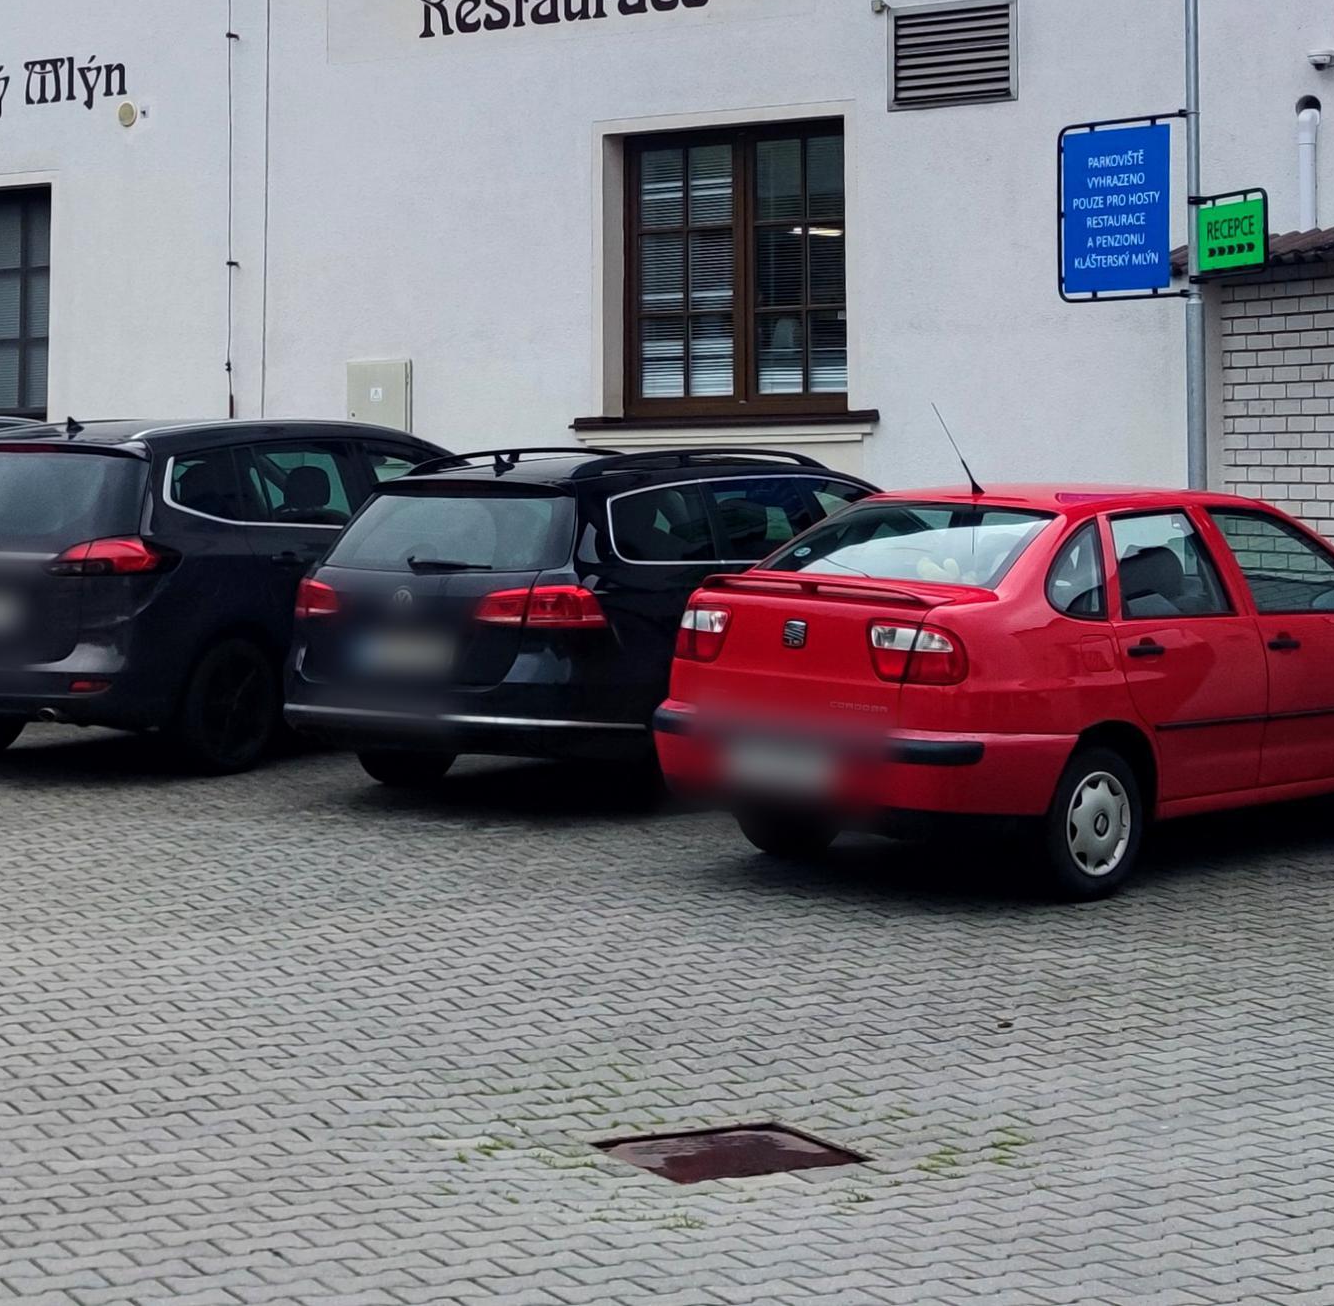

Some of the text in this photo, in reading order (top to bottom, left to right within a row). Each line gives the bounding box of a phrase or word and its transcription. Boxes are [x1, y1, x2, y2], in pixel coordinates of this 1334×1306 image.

[23, 55, 128, 110] Mlýn
[1087, 149, 1145, 169] PARKOVIŠTĚ
[1086, 172, 1145, 189] VYHRAZENO
[1072, 191, 1160, 210] POUZE PRO HOSTY
[1086, 212, 1146, 229] RESTAURACE
[1207, 214, 1255, 242] RECEPCE
[1087, 233, 1145, 248] A PENZIONU
[1074, 249, 1159, 269] KLÁŠTERSKÝ MLÝN
